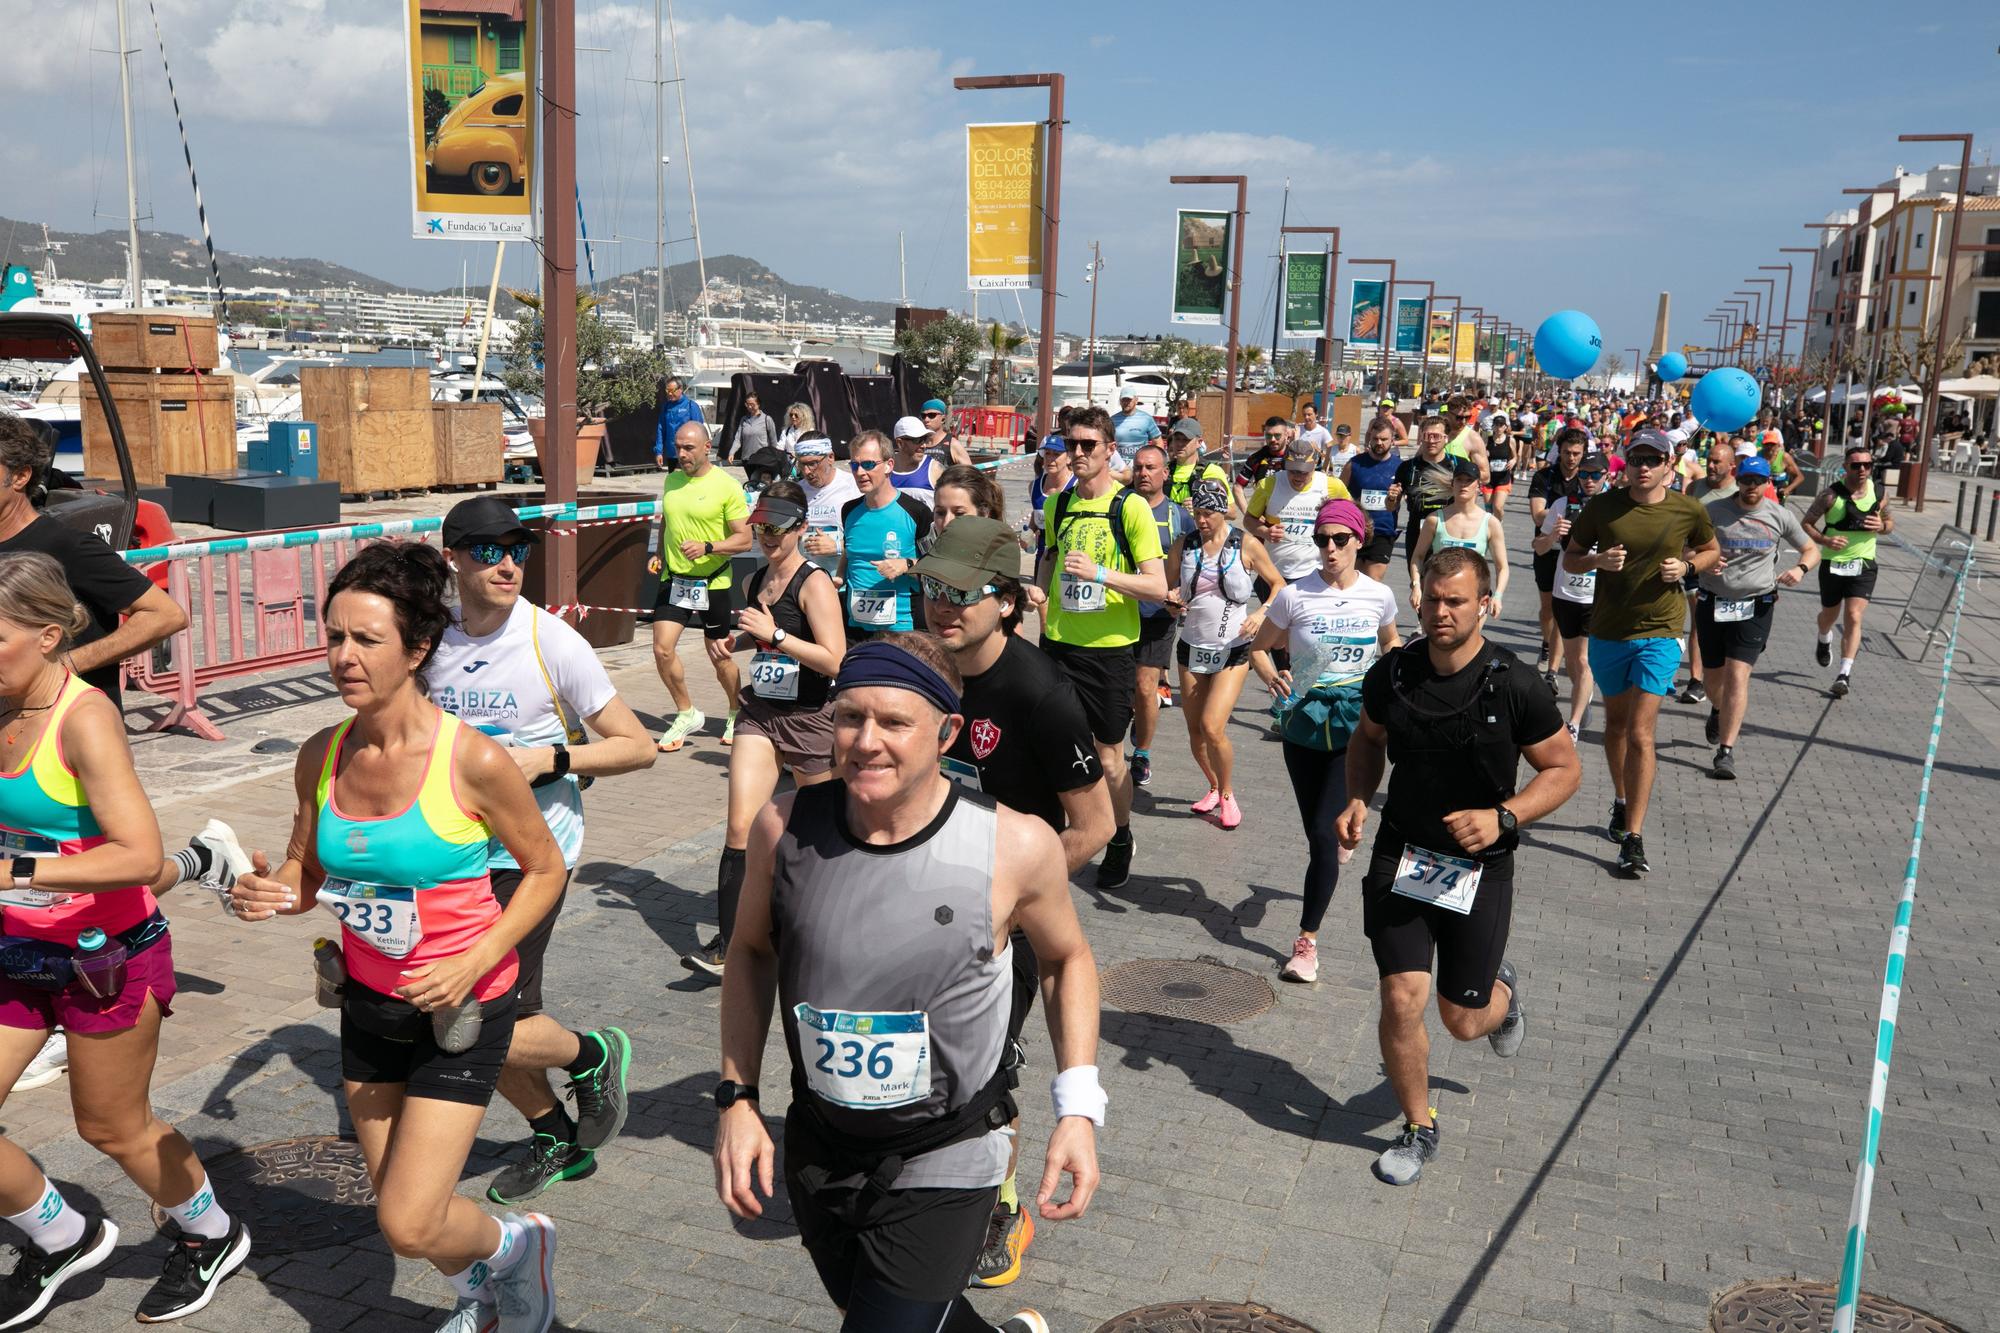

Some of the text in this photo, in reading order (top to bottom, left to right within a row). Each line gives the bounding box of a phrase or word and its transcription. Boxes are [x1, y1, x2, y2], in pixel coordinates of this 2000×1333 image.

[974, 147, 1036, 163] COLORS
[974, 163, 1002, 177] DEL
[447, 220, 487, 232] Fundació
[1289, 264, 1323, 273] COLORS
[1289, 272, 1305, 280] DEL
[979, 278, 1033, 288] CaixaForum
[1364, 495, 1382, 505] 561
[811, 506, 837, 515] IBIZA
[1285, 524, 1309, 536] 447
[1569, 576, 1592, 588] 222
[676, 586, 701, 601] 318
[1065, 584, 1092, 600] 460
[857, 600, 885, 614] 374
[1721, 602, 1745, 613] 394
[1331, 618, 1370, 628] IBIZA
[1196, 651, 1221, 665] 596
[753, 664, 785, 684] 439
[462, 691, 518, 710] IBIZA
[461, 708, 519, 719] MARATHON
[1409, 859, 1461, 890] 574
[333, 901, 393, 935] 233
[377, 936, 406, 946] Kethlin
[7, 972, 57, 981] NATHAN
[815, 1037, 895, 1080] 236
[880, 1081, 910, 1092] Mark
